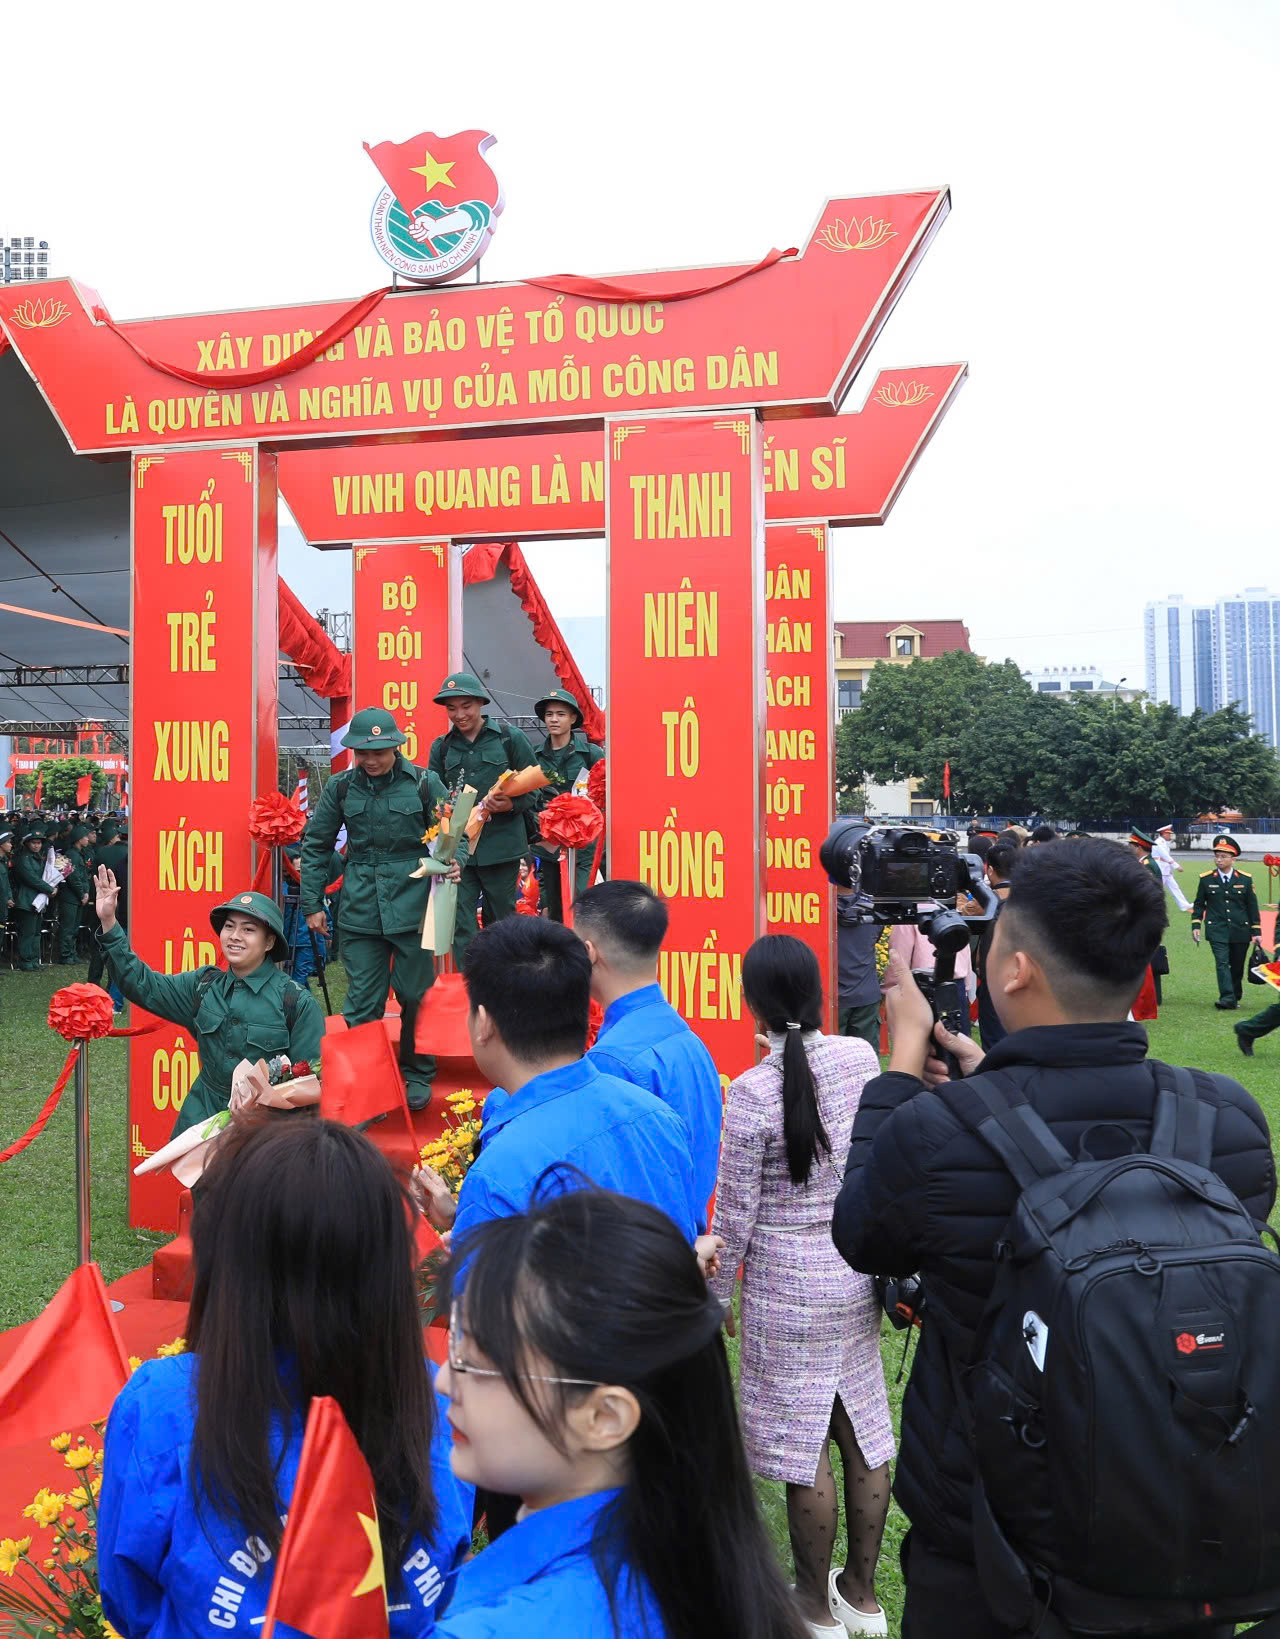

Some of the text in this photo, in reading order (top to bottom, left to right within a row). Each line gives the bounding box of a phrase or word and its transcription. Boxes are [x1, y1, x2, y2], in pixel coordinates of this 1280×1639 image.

[198, 332, 252, 371] XÂY
[354, 318, 392, 358] VÀ
[404, 309, 465, 353] BẢO
[477, 306, 514, 354] VỆ
[525, 296, 563, 344] TỔ
[107, 396, 139, 434] LÀ
[252, 384, 289, 423] VÀ
[300, 378, 392, 420] NGHĨA
[403, 378, 442, 418] VỤ
[454, 365, 517, 408] CỦA
[528, 355, 590, 403] MỖI
[604, 355, 694, 397] CÔNG
[708, 347, 778, 389] DÂN
[333, 473, 403, 515] VINH
[416, 466, 520, 515] QUANG
[532, 456, 570, 504] LÀ
[812, 438, 846, 489] SĨ
[630, 472, 731, 539] THANH
[163, 478, 222, 564] TUỔI
[167, 590, 216, 672] TRẺ
[383, 576, 416, 615] BỘ
[645, 577, 717, 656] NIÊN
[378, 626, 421, 666] ĐỘI
[384, 682, 417, 716] CỤ
[154, 720, 228, 782] XUNG
[401, 723, 417, 760] Ồ
[662, 696, 698, 777] TÔ
[766, 730, 814, 767] ẠNG
[160, 817, 222, 891] KÍCH
[640, 808, 723, 898] HỒNG
[208, 1576, 246, 1629] CHI
